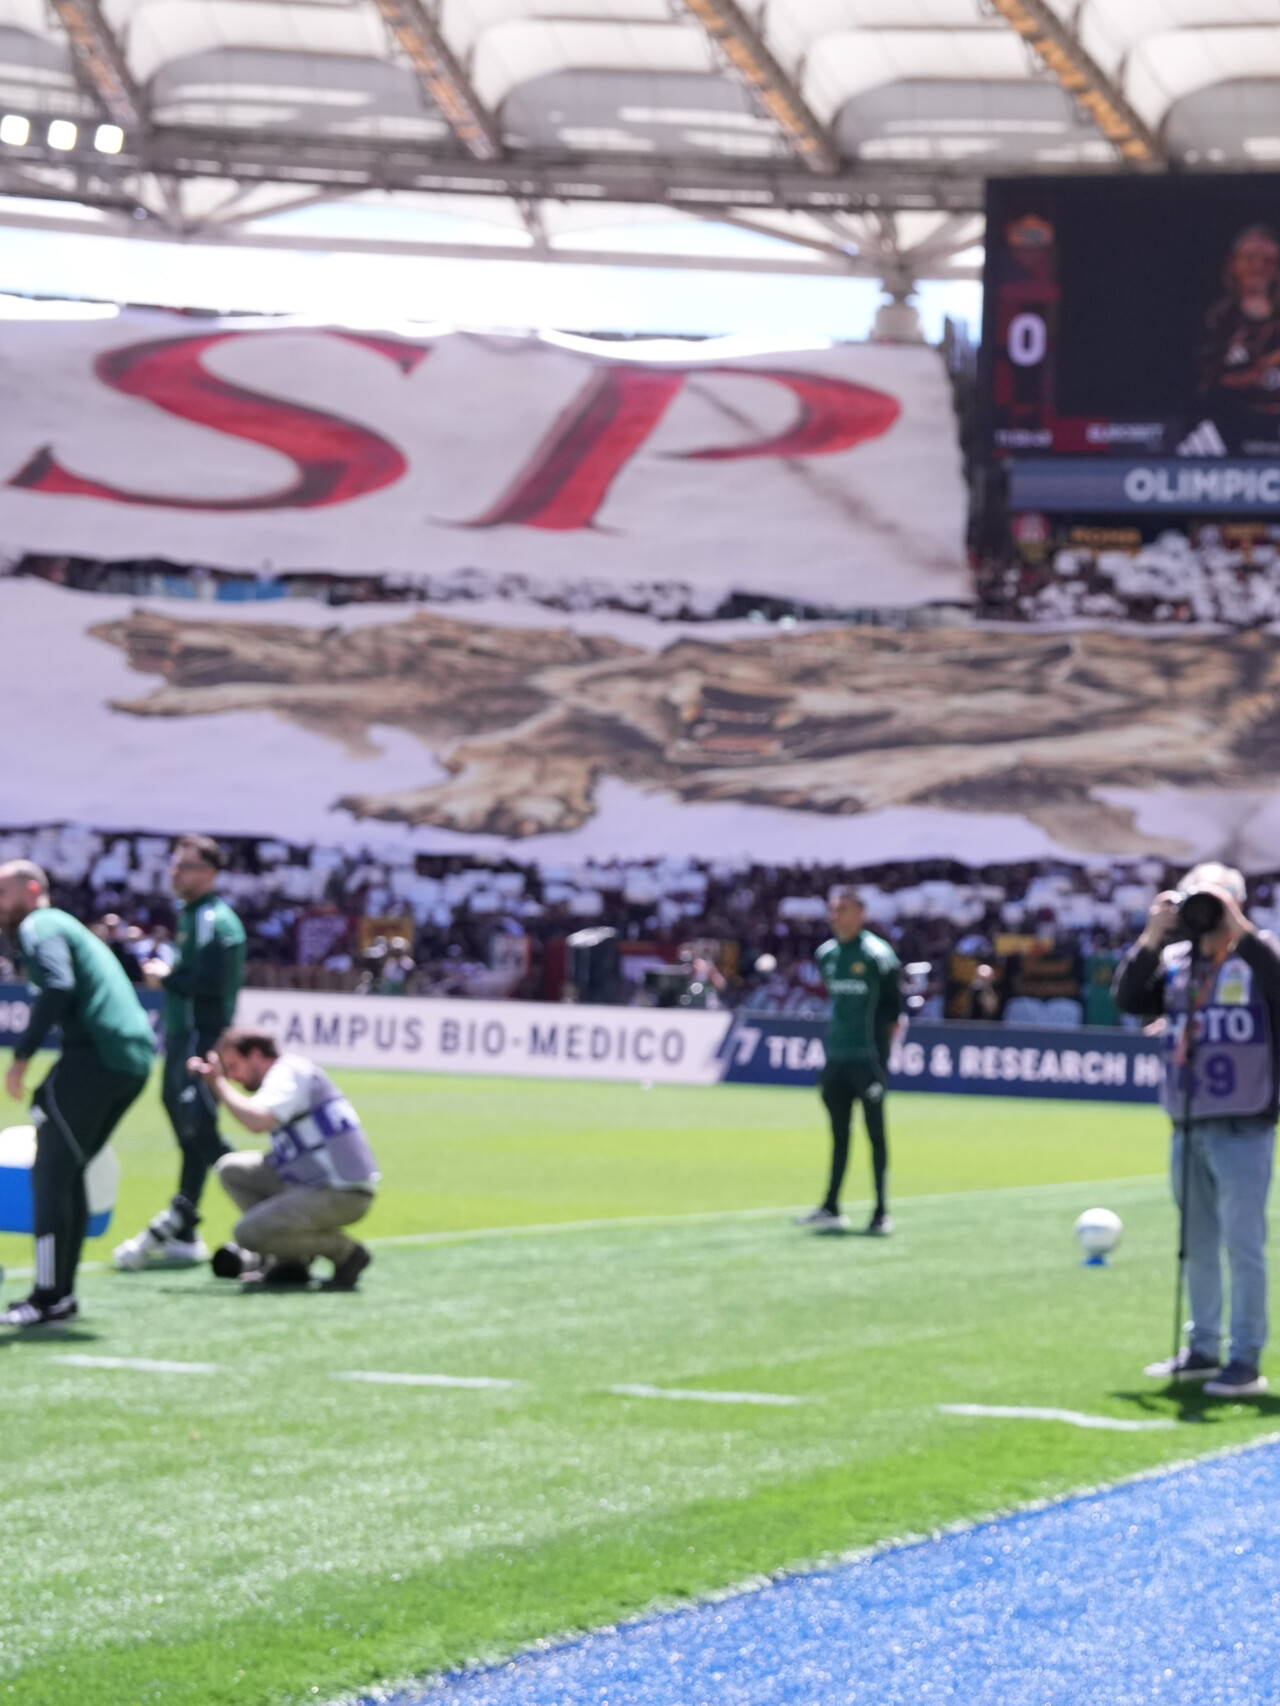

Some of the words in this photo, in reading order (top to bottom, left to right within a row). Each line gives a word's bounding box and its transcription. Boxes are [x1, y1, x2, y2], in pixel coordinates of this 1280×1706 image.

[1007, 312, 1047, 367] 0
[257, 1009, 422, 1053] CAMPUS
[440, 1017, 685, 1065] BIO-MEDICO
[928, 1043, 954, 1078] &
[958, 1045, 1127, 1086] RESEARCH
